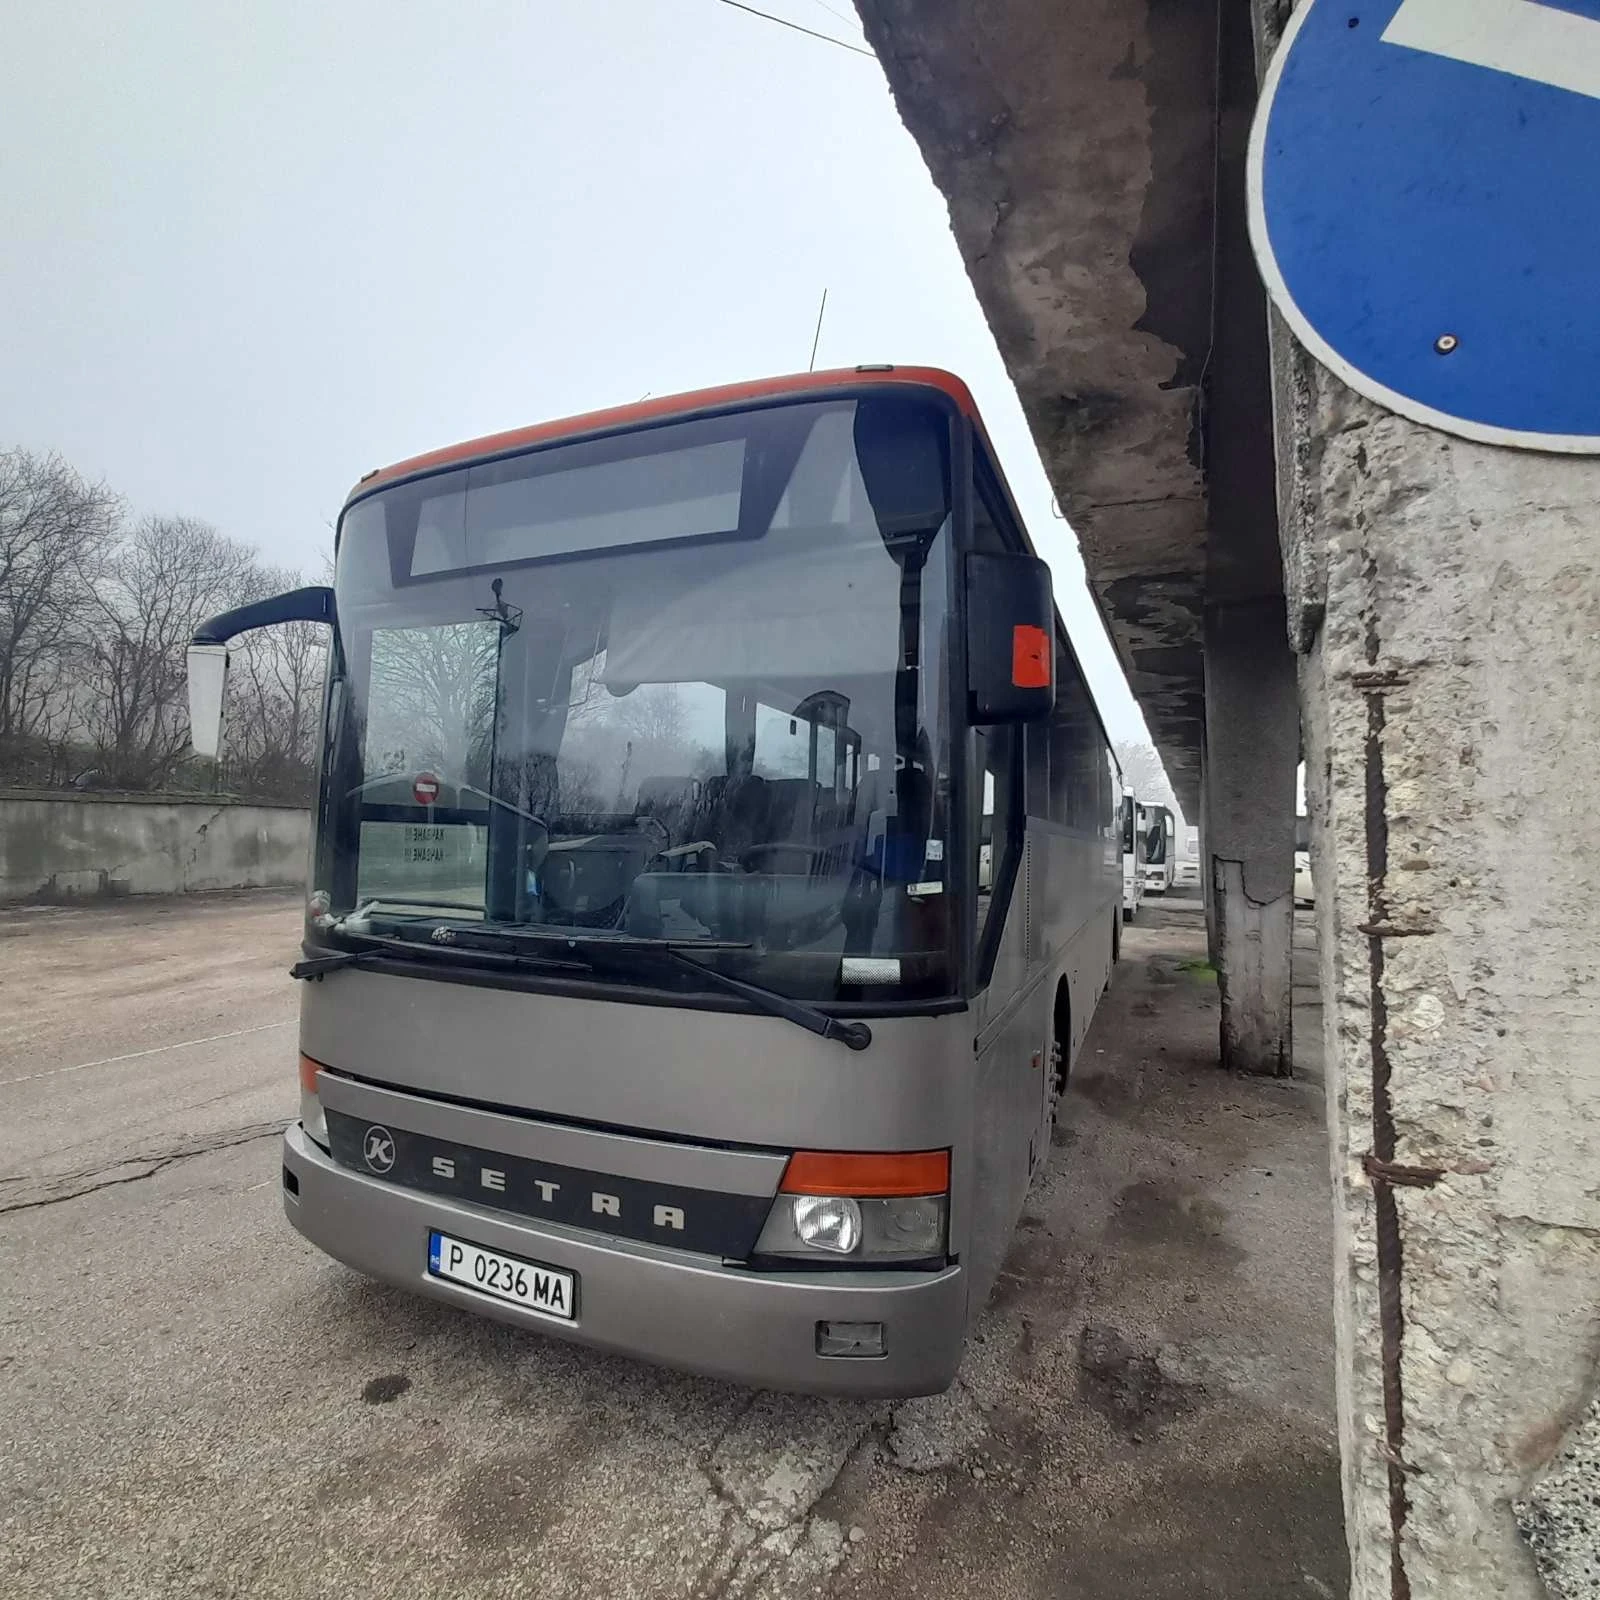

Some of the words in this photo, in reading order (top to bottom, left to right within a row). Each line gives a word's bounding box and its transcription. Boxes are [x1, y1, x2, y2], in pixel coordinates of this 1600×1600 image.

[432, 1156, 685, 1230] SETRA
[449, 1244, 464, 1271] P
[474, 1254, 528, 1297] 0236
[533, 1272, 565, 1310] MA
